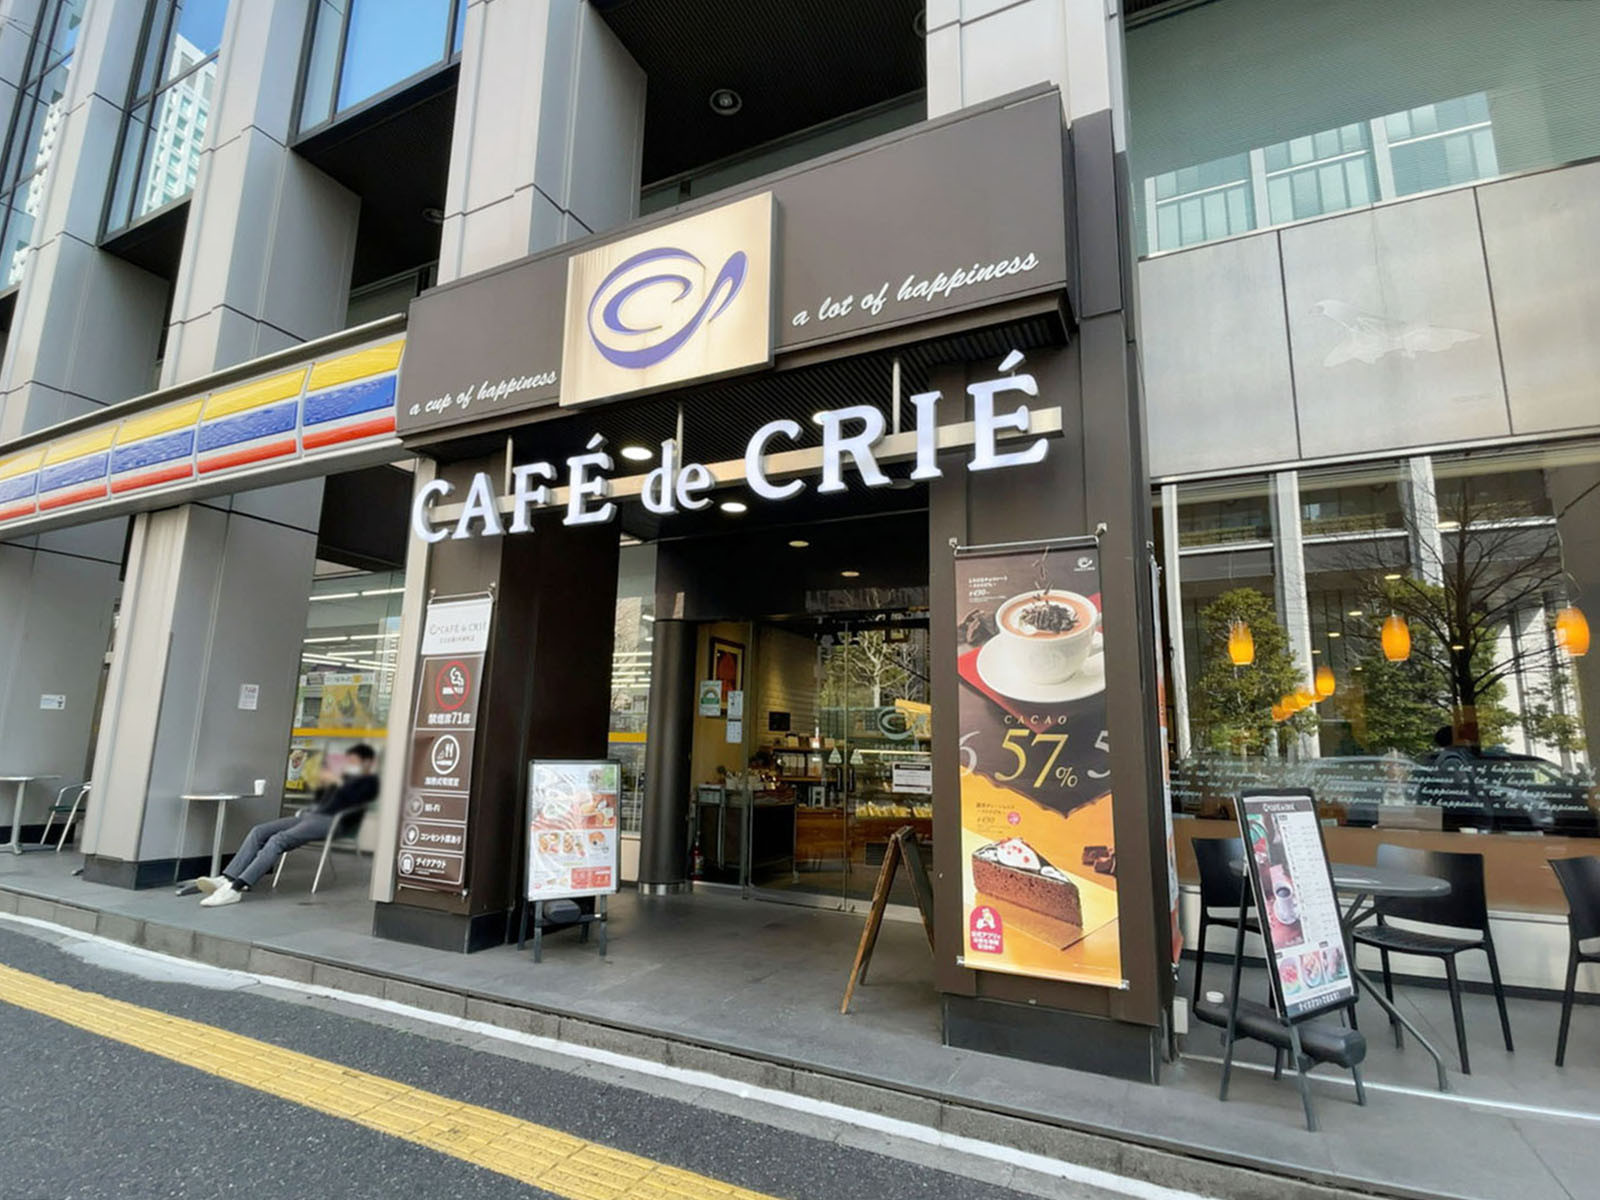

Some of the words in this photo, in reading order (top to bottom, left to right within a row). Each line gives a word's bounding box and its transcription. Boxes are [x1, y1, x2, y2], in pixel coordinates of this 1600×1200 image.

[791, 310, 810, 326] a
[818, 296, 854, 321] lot
[860, 282, 889, 316] of
[896, 252, 1040, 302] happiness
[409, 403, 421, 415] a
[424, 393, 453, 414] cup
[456, 384, 475, 409] of
[476, 370, 558, 402] happiness
[411, 432, 617, 543] CAFÉ
[640, 438, 717, 515] de
[744, 349, 1050, 500] CRIÉ
[1004, 714, 1068, 726] CACAO
[994, 728, 1078, 789] 57%
[1421, 785, 1470, 796] happiness
[1435, 798, 1485, 809] happiness
[1537, 801, 1590, 812] happiness
